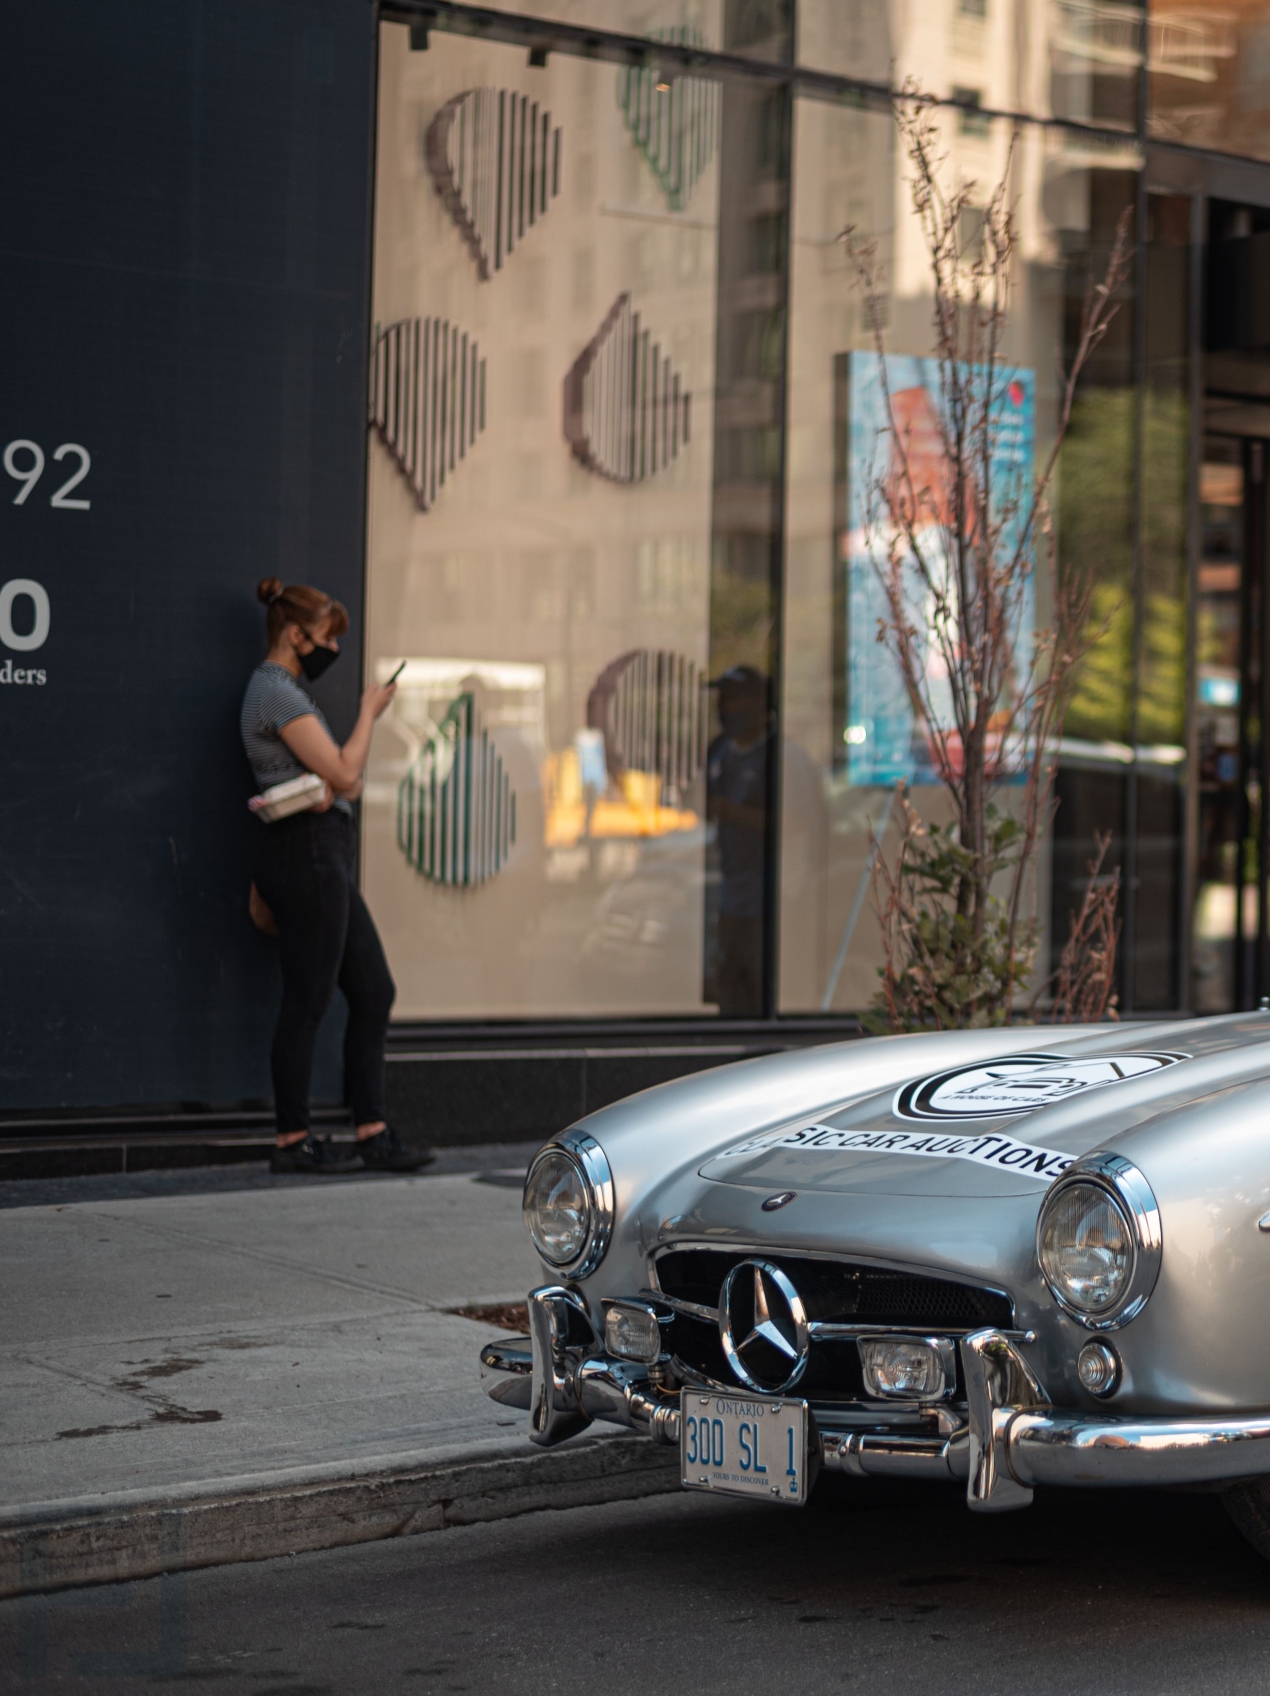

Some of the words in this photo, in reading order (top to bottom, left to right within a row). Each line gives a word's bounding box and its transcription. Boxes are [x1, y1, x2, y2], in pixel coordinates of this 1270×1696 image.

[3, 438, 91, 511] 92
[838, 1134, 910, 1150] CAR
[907, 1136, 1077, 1178] AUCTIONS
[716, 1398, 765, 1418] ONTARIO
[686, 1415, 724, 1467] 300
[739, 1422, 768, 1473] SL
[786, 1426, 797, 1476] 1
[713, 1471, 730, 1482] YOURS
[731, 1474, 740, 1482] TO
[740, 1474, 770, 1486] DISCOVER
